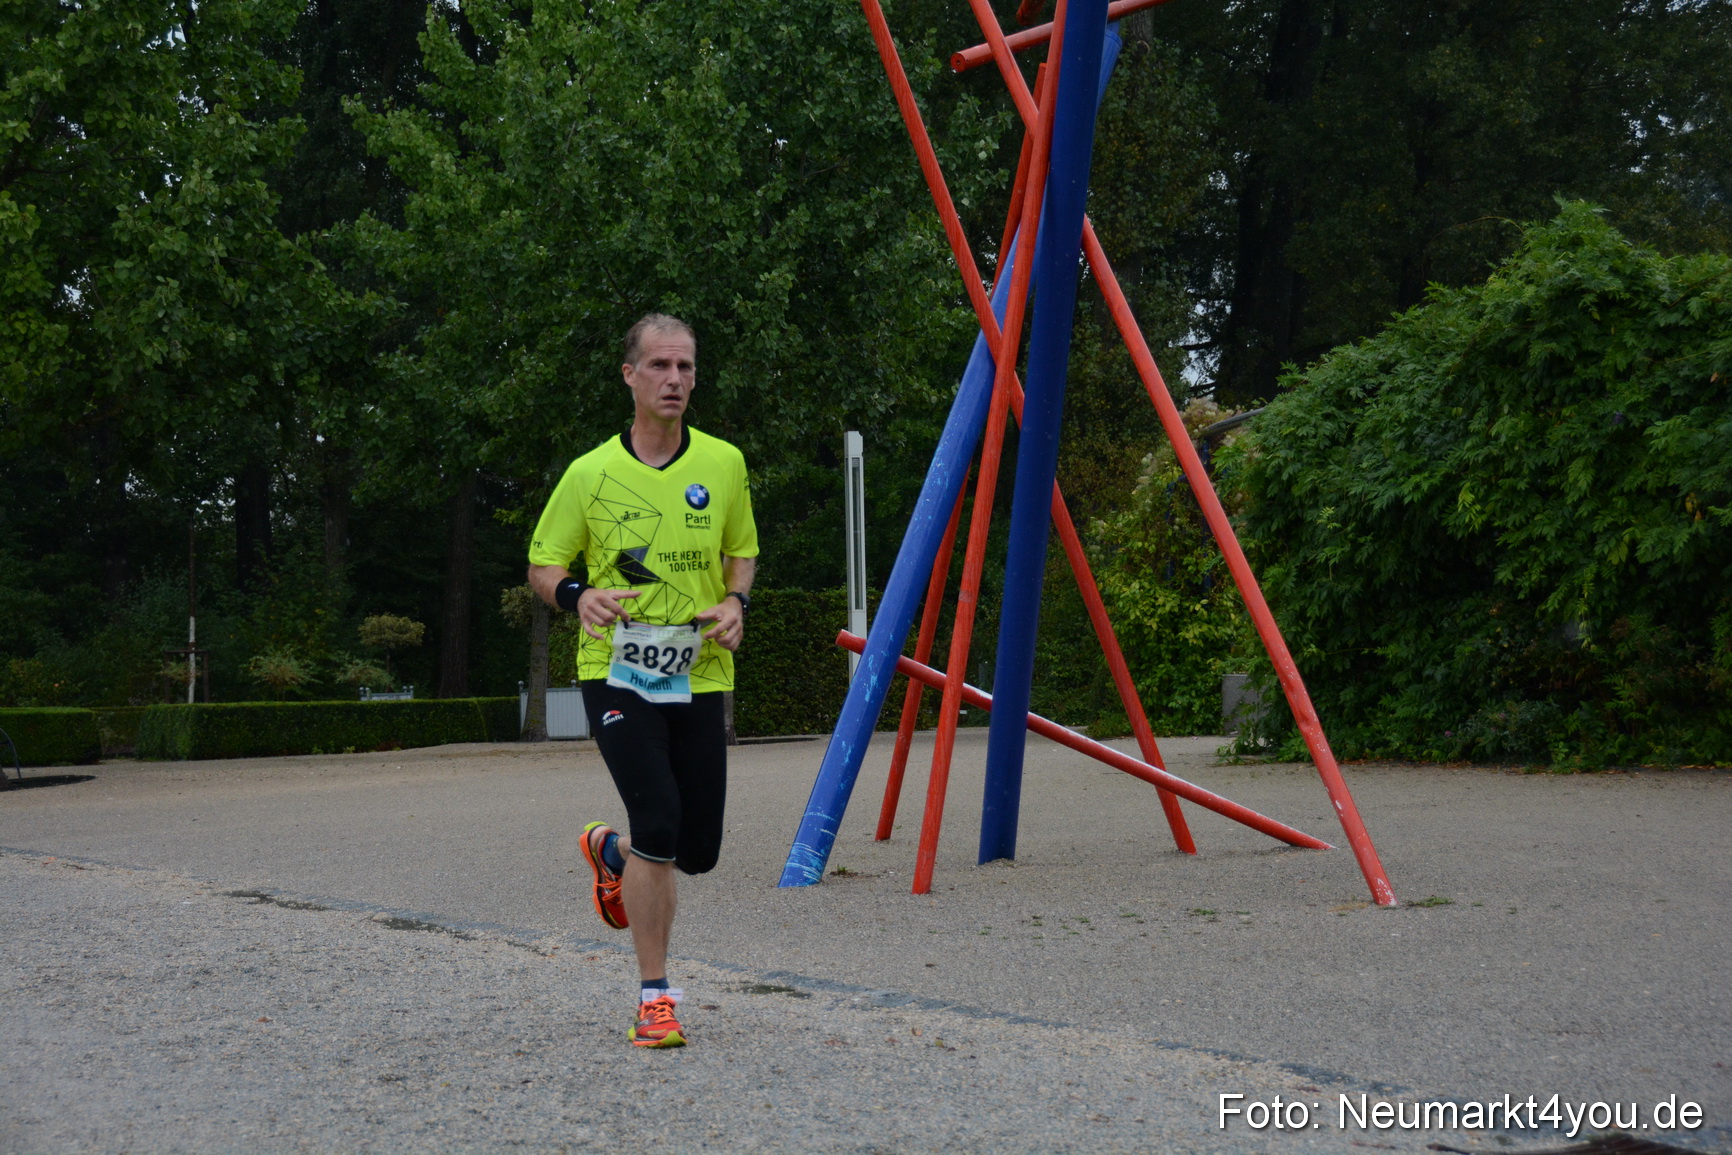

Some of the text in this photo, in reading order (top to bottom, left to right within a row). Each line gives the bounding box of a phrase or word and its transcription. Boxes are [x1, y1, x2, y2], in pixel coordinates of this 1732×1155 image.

[685, 513, 711, 524] Partl
[657, 550, 702, 562] THE NEXT
[669, 562, 687, 572] 100
[623, 642, 694, 676] 2828
[630, 672, 673, 691] Helmuth
[603, 714, 624, 725] skinfit
